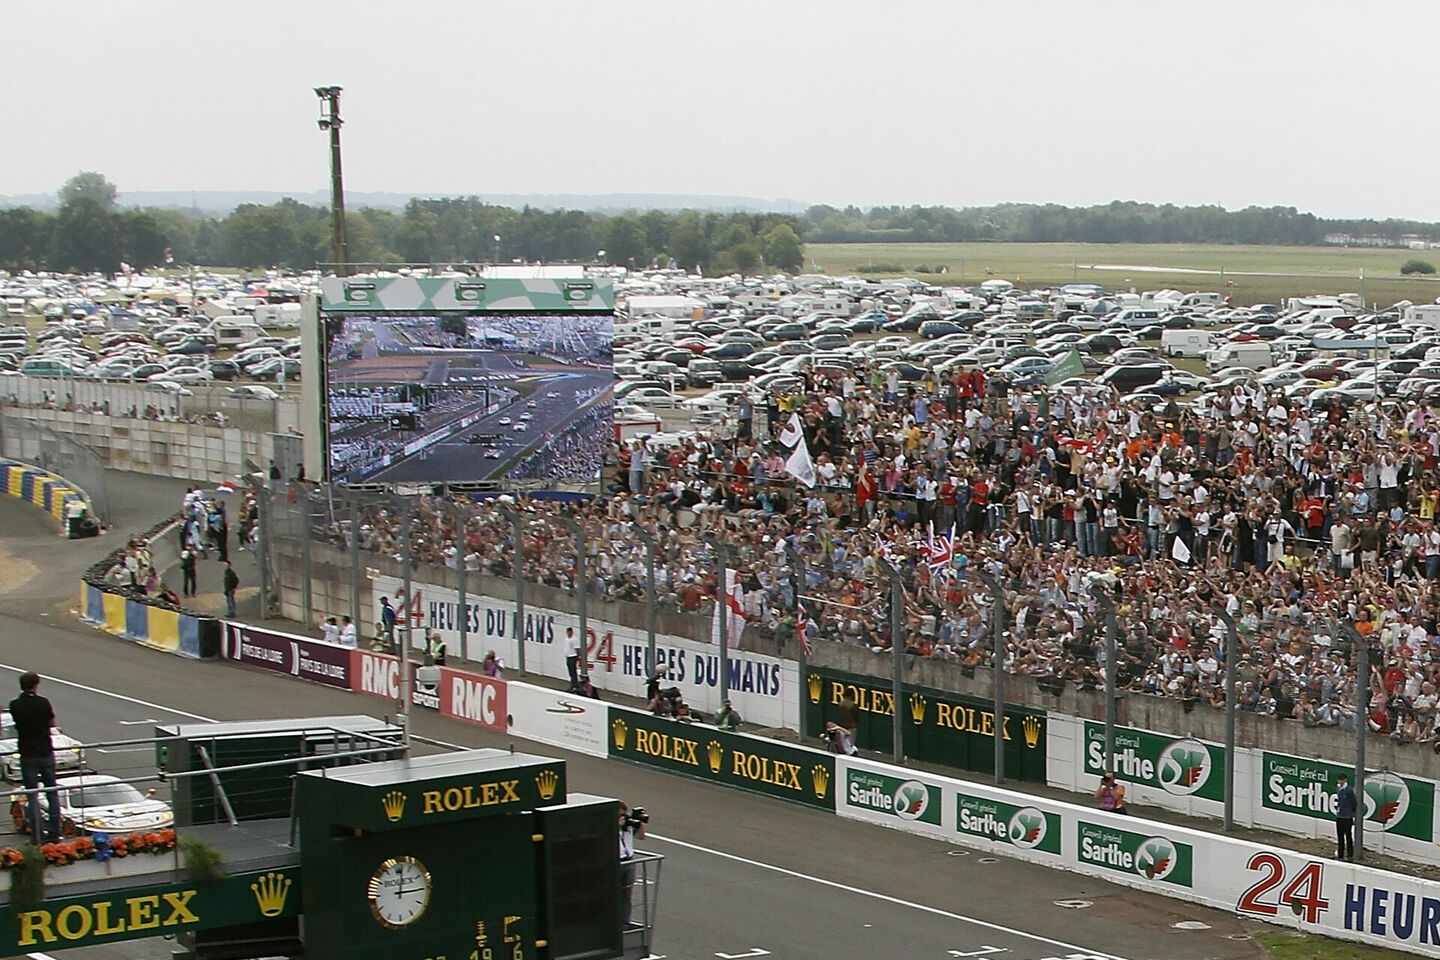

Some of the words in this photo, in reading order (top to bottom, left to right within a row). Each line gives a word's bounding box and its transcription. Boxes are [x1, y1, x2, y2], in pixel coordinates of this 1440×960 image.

[430, 601, 479, 633] HEUES
[487, 608, 505, 637] DU
[361, 655, 399, 699] RMC
[695, 655, 719, 688] DU
[728, 659, 781, 697] MANS
[452, 677, 497, 725] RMC
[636, 728, 699, 766] ROLEX
[732, 750, 802, 791] ROLEX
[1270, 760, 1299, 779] Conseil
[423, 780, 520, 813] ROLEX
[850, 783, 892, 810] Sarthe
[1269, 775, 1338, 814] Sarthe
[960, 809, 1007, 839] Sarthe
[1082, 837, 1133, 868] Sarthe
[384, 876, 415, 888] ROLEX
[1236, 851, 1330, 924] 24
[17, 889, 200, 946] ROLEX
